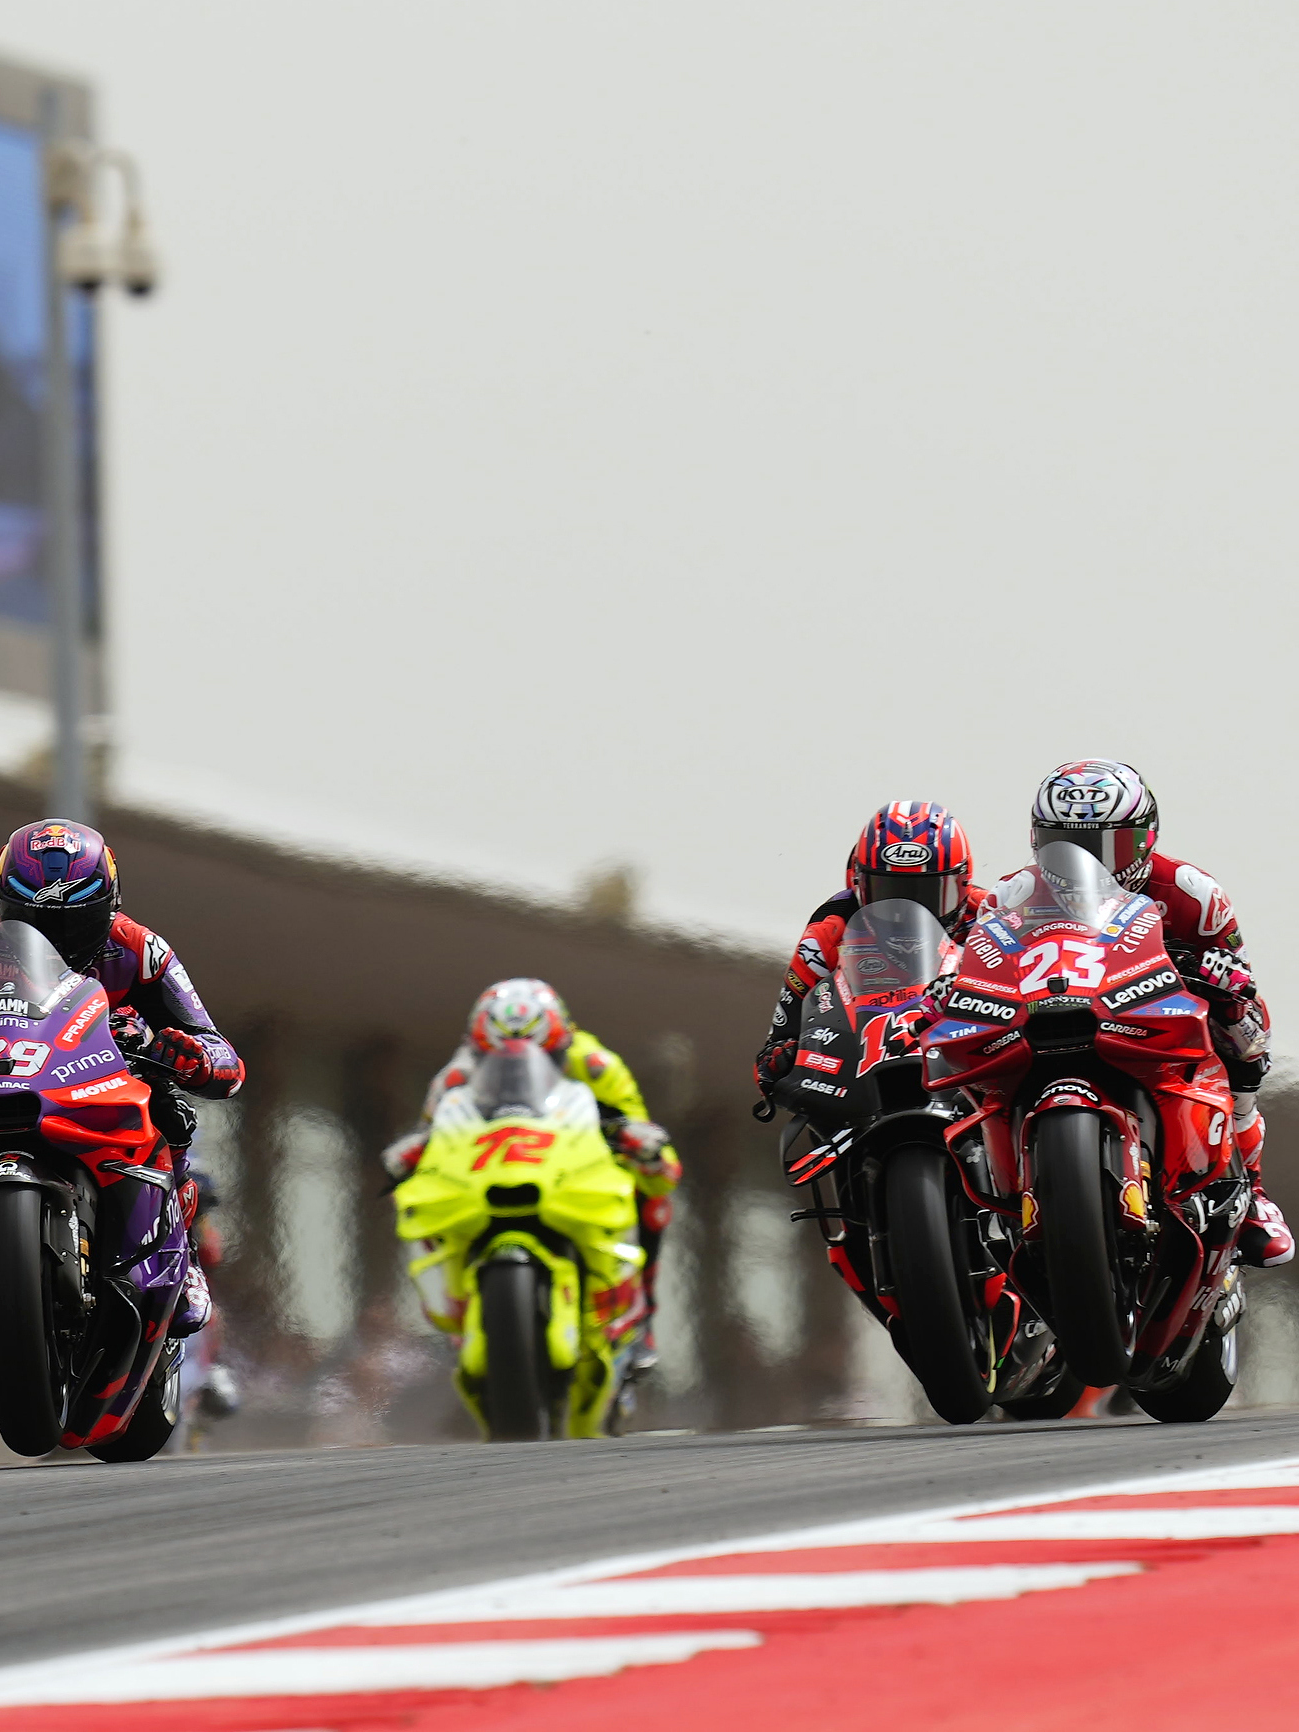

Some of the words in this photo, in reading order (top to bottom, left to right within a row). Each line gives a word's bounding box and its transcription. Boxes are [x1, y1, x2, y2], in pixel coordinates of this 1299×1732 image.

[1062, 789, 1104, 800] KYT
[885, 846, 923, 858] Arai
[1018, 939, 1106, 995] 23
[869, 990, 918, 1006] aprilia
[1101, 971, 1176, 1010] Lenovo
[948, 991, 1016, 1020] Lenovo
[62, 999, 106, 1042] PRAMAC
[949, 1026, 978, 1039] TIM
[1100, 1022, 1147, 1036] CARRERA
[811, 1027, 840, 1046] sky
[983, 1030, 1021, 1055] CARRERA
[50, 1049, 116, 1083] prima
[71, 1076, 128, 1101] MOTUL
[801, 1078, 835, 1094] CASE
[471, 1127, 555, 1171] 72
